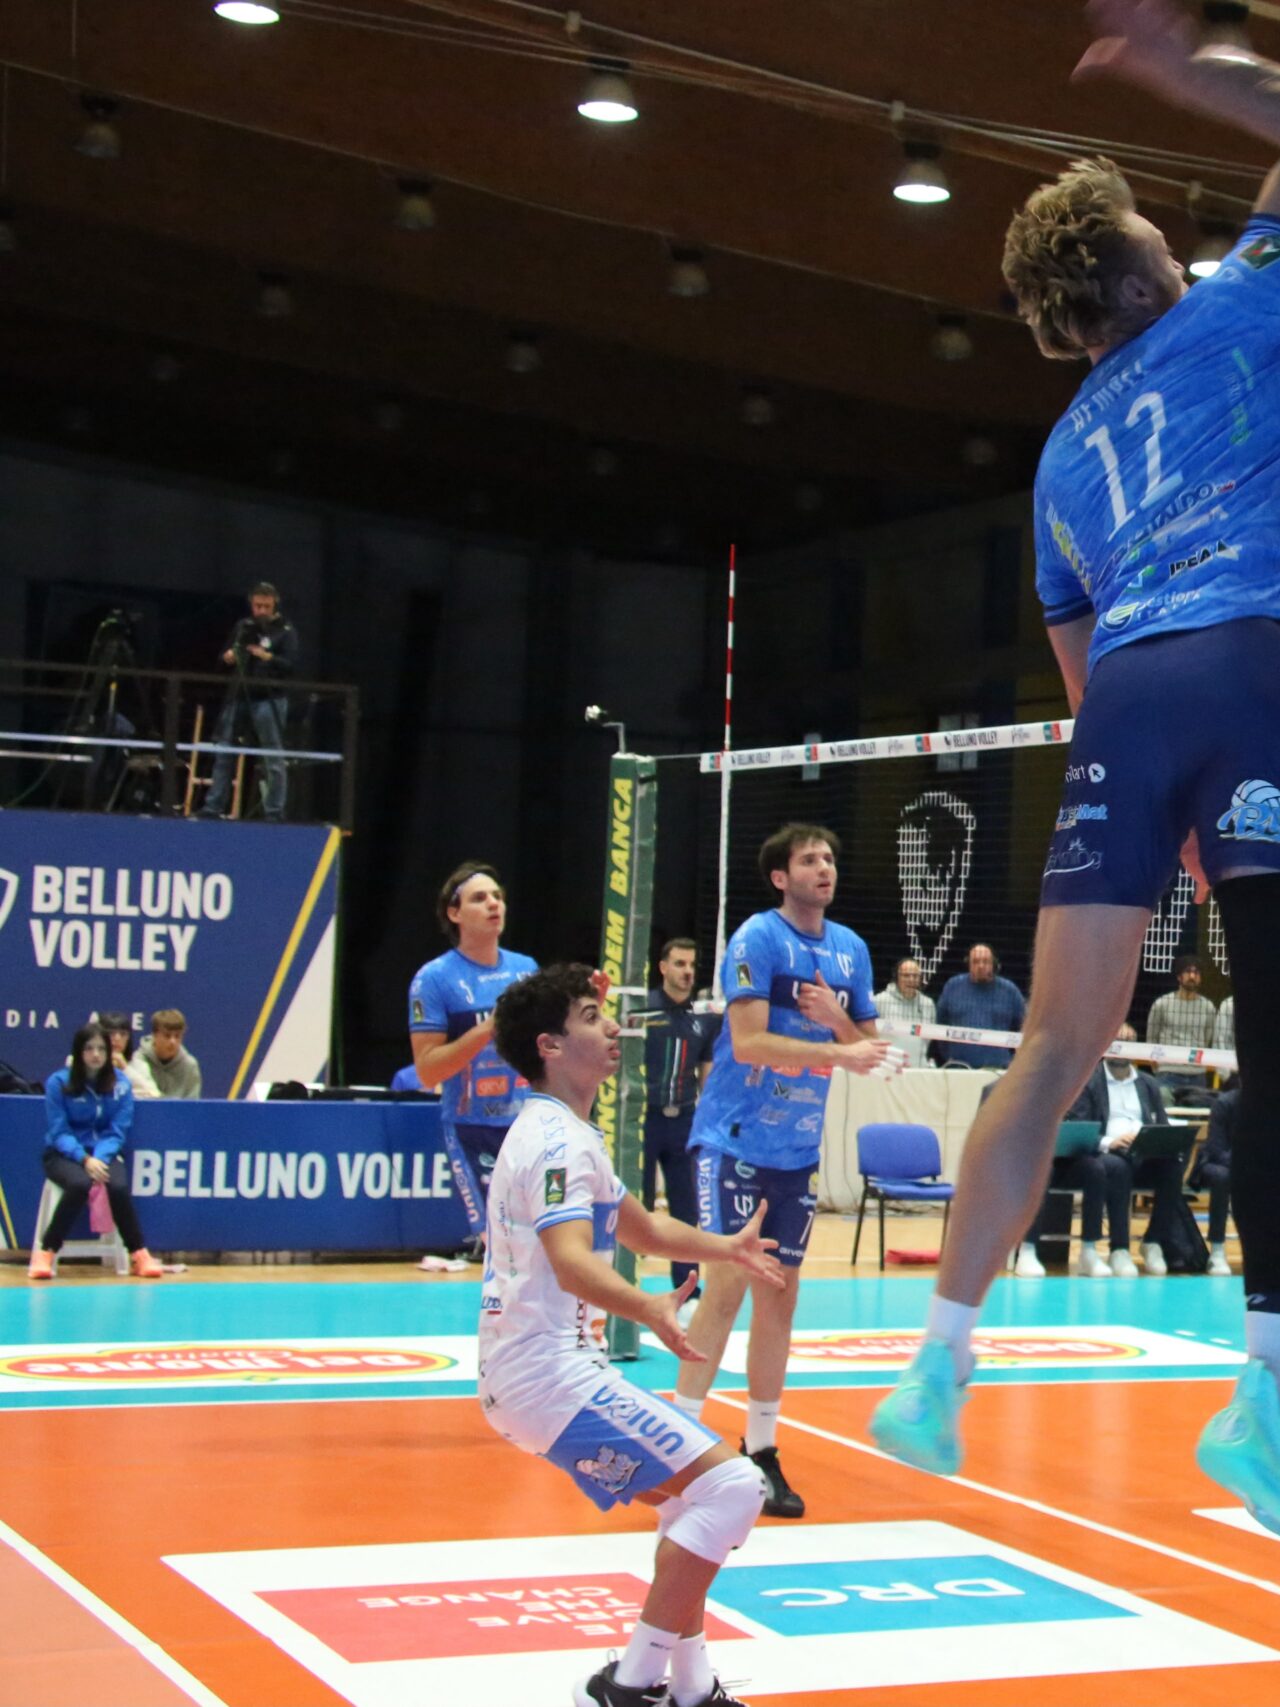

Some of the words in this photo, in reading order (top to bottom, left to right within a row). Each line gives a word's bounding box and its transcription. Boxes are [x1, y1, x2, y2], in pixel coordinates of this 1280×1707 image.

[609, 778, 633, 897] BANCA
[32, 865, 233, 921] BELLUNO
[29, 918, 197, 972] VOLLEY
[131, 1149, 327, 1200] BELLUNO
[337, 1152, 452, 1200] VOLLE
[357, 1586, 613, 1609] CHANGE
[516, 1597, 640, 1612] THE
[759, 1578, 1026, 1607] DRC
